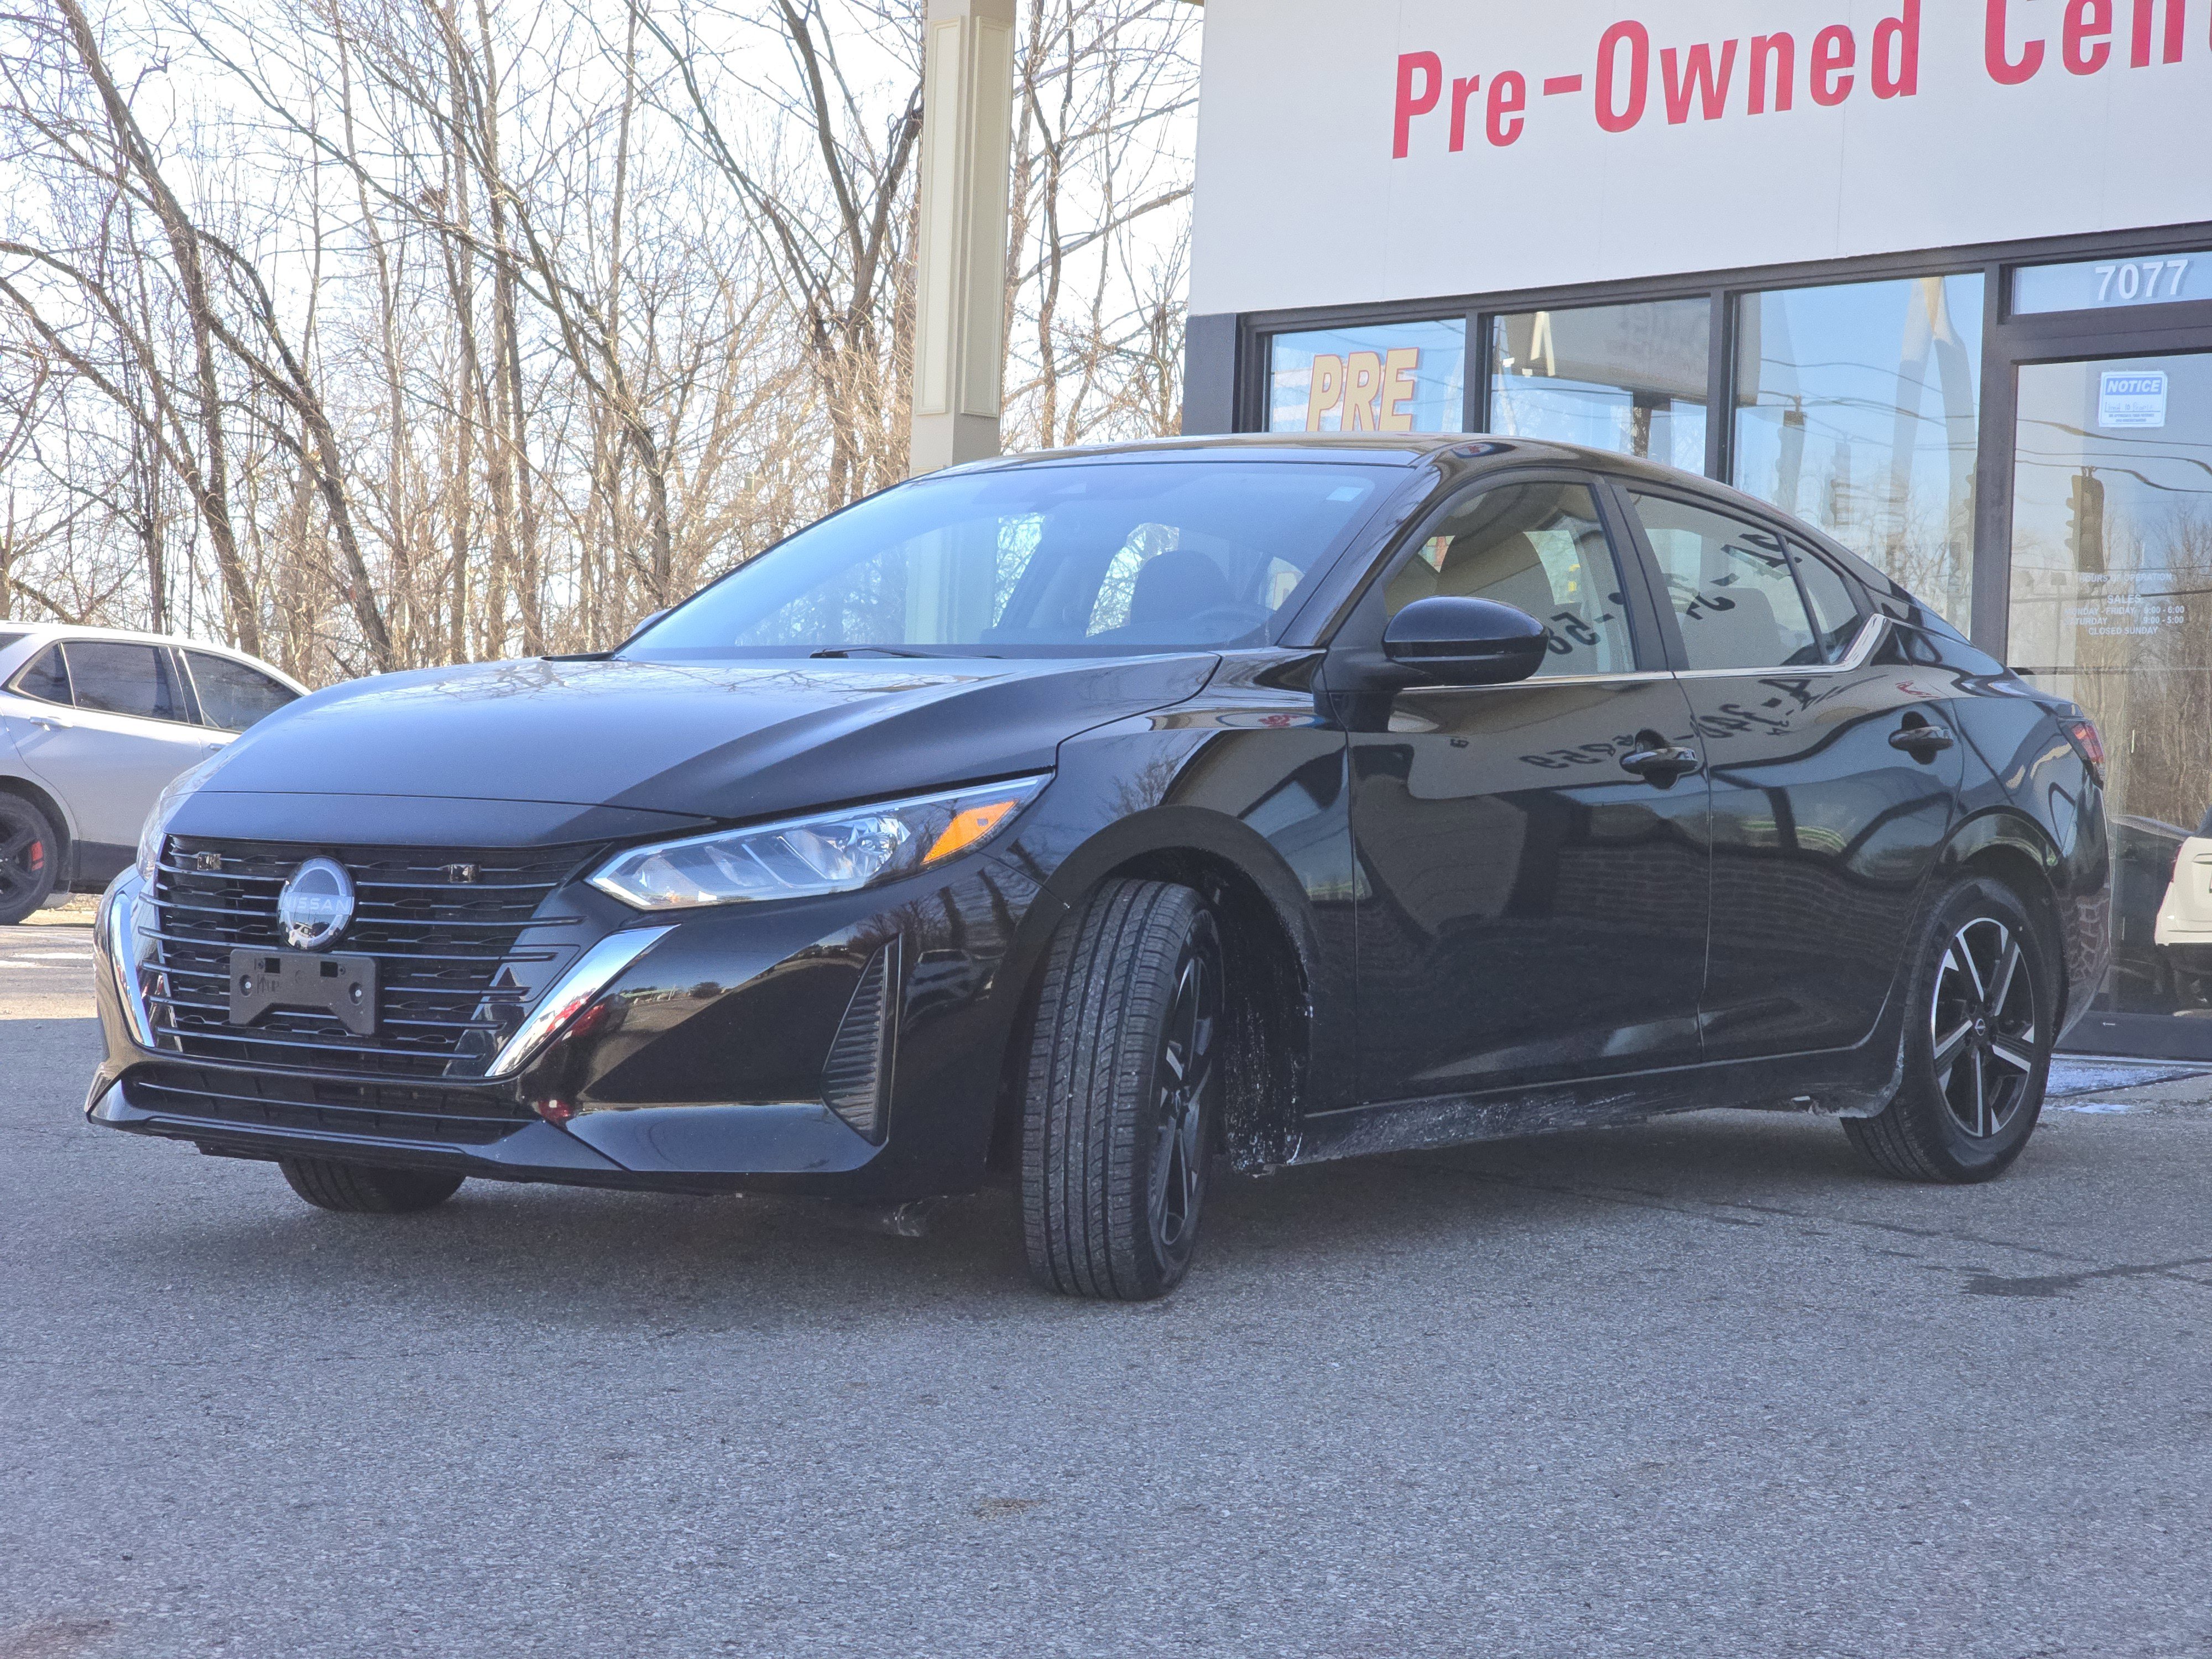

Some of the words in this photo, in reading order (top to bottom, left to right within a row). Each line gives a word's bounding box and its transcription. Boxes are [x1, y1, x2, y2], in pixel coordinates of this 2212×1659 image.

[1392, 0, 1921, 159] Pre-Owned
[1984, 0, 2212, 85] Cen
[2095, 259, 2188, 301] 7077
[1306, 347, 1420, 431] PRE
[2106, 379, 2161, 393] NOTICE
[2107, 594, 2142, 604] SALES
[2106, 607, 2135, 615] FRIDAY
[2142, 616, 2159, 624] 9:00
[2167, 615, 2184, 624] 5:00
[2088, 627, 2122, 635] CLOSED
[2124, 626, 2158, 635] SUNDAY
[281, 896, 349, 912] NISSAN
